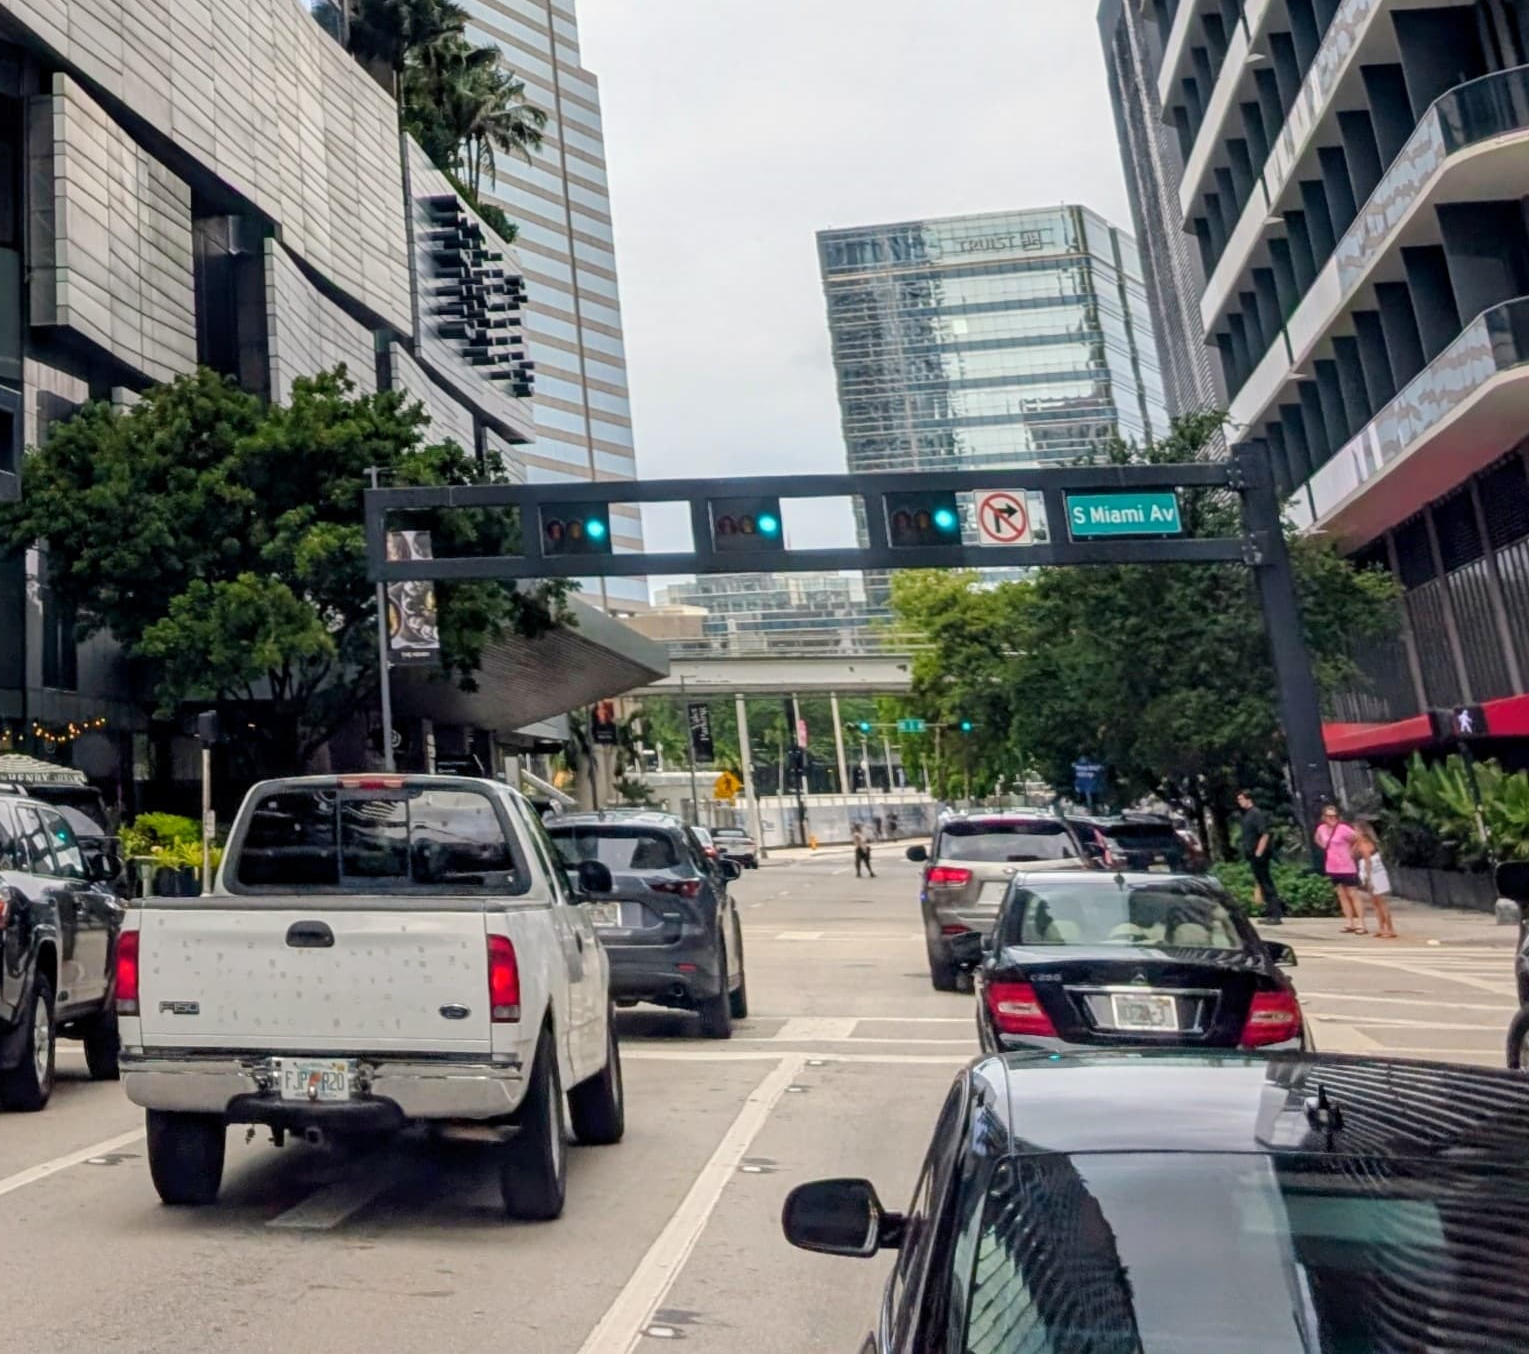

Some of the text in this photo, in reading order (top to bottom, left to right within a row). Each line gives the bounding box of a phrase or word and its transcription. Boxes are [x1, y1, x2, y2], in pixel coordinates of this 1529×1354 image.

[958, 235, 1017, 253] TRUIST
[1072, 503, 1174, 524] S Miami Av
